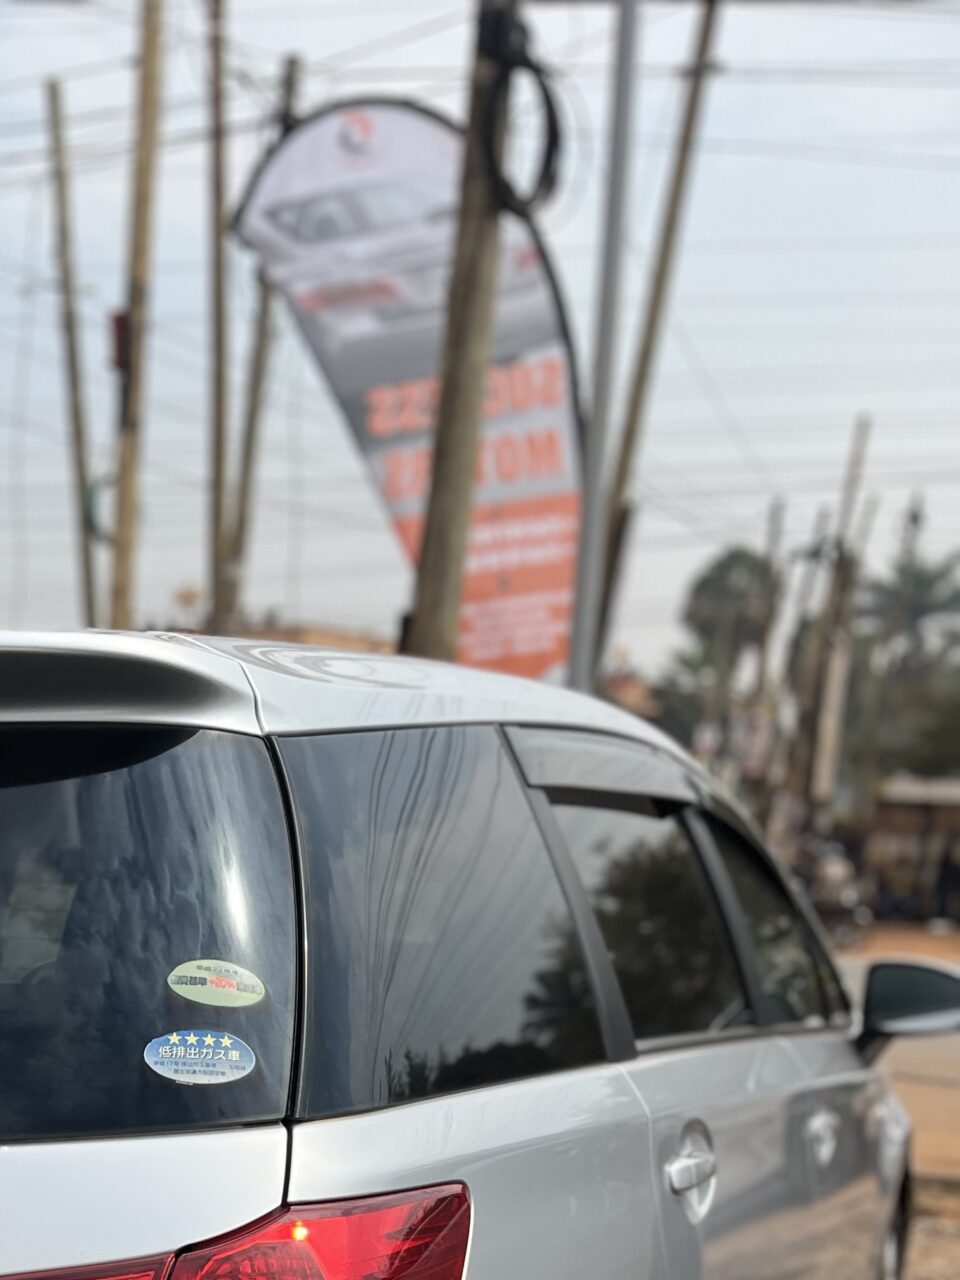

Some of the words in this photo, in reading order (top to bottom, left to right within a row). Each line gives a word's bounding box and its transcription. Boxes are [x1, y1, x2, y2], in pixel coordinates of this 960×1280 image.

[159, 1046, 240, 1061] 低排出ガス車
